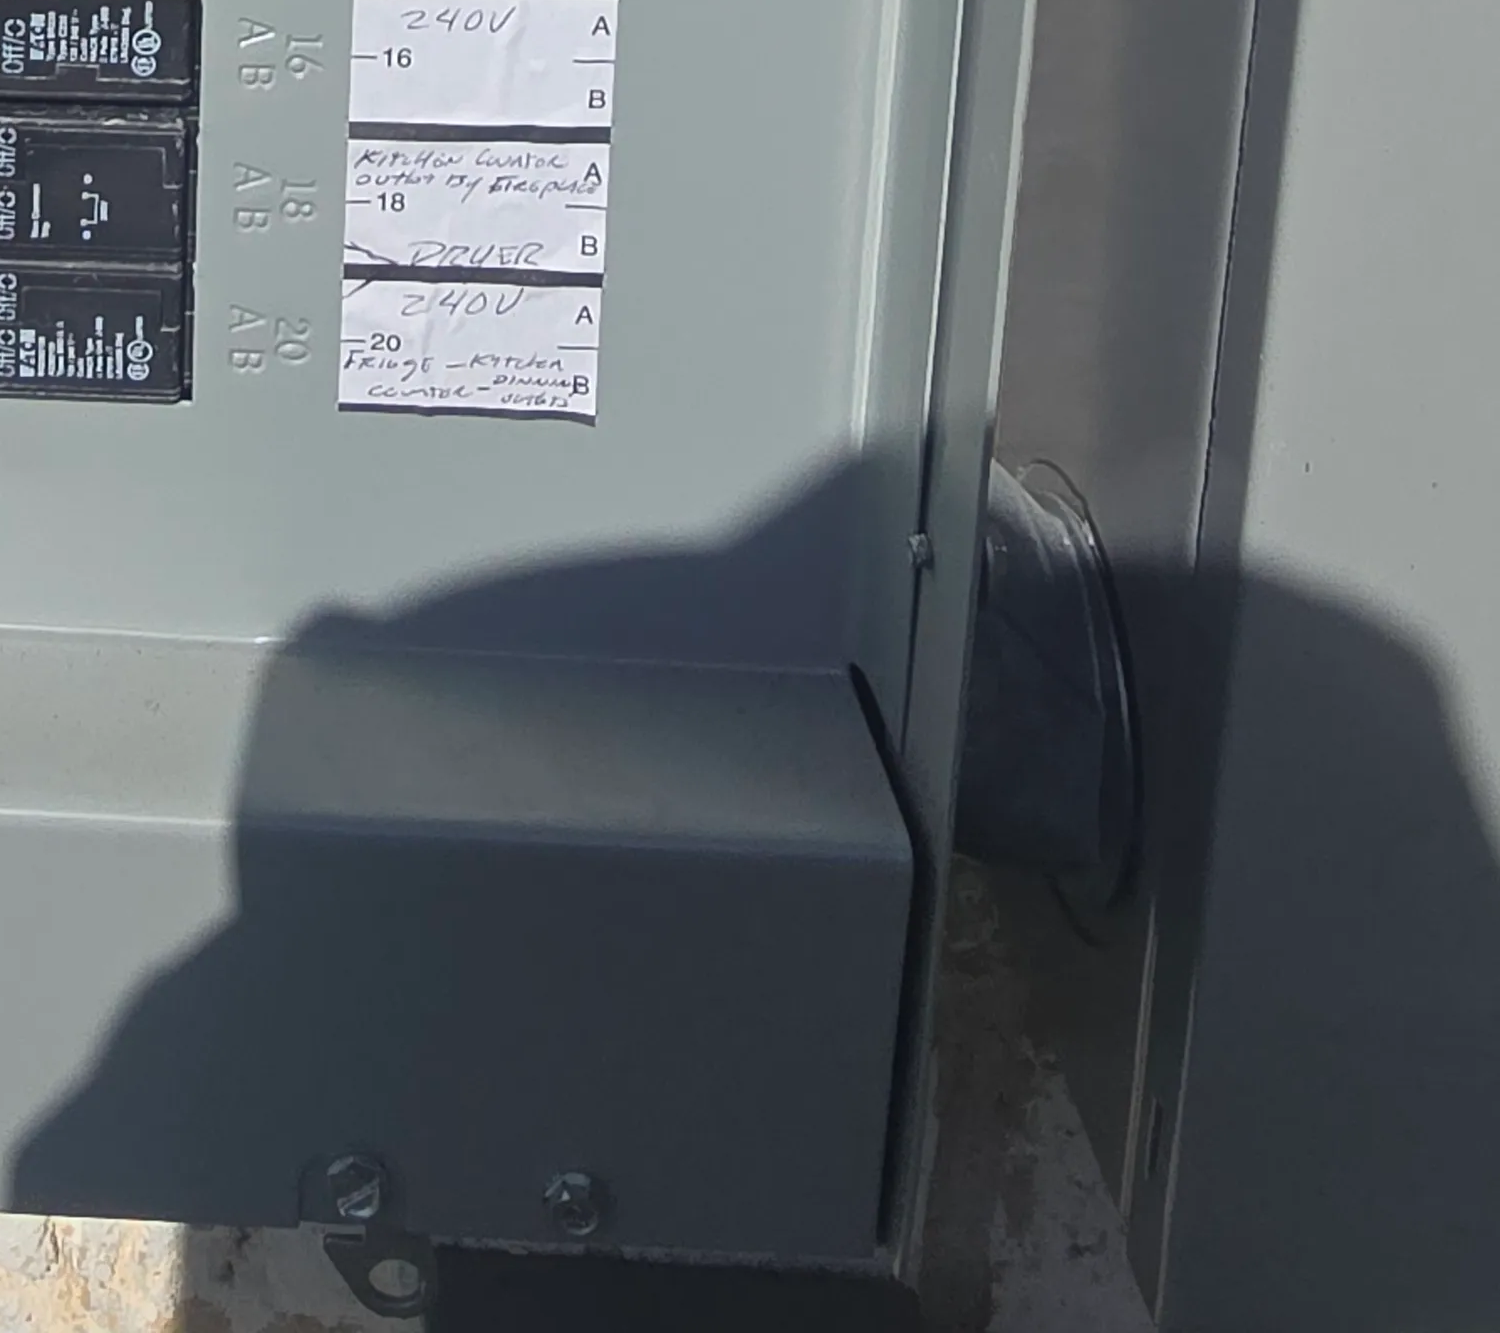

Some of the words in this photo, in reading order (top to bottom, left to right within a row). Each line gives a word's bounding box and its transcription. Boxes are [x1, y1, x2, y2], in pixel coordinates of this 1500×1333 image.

[401, 5, 518, 33] 240V
[384, 49, 411, 68] 16
[378, 193, 404, 211] 18
[371, 333, 401, 351] 20
